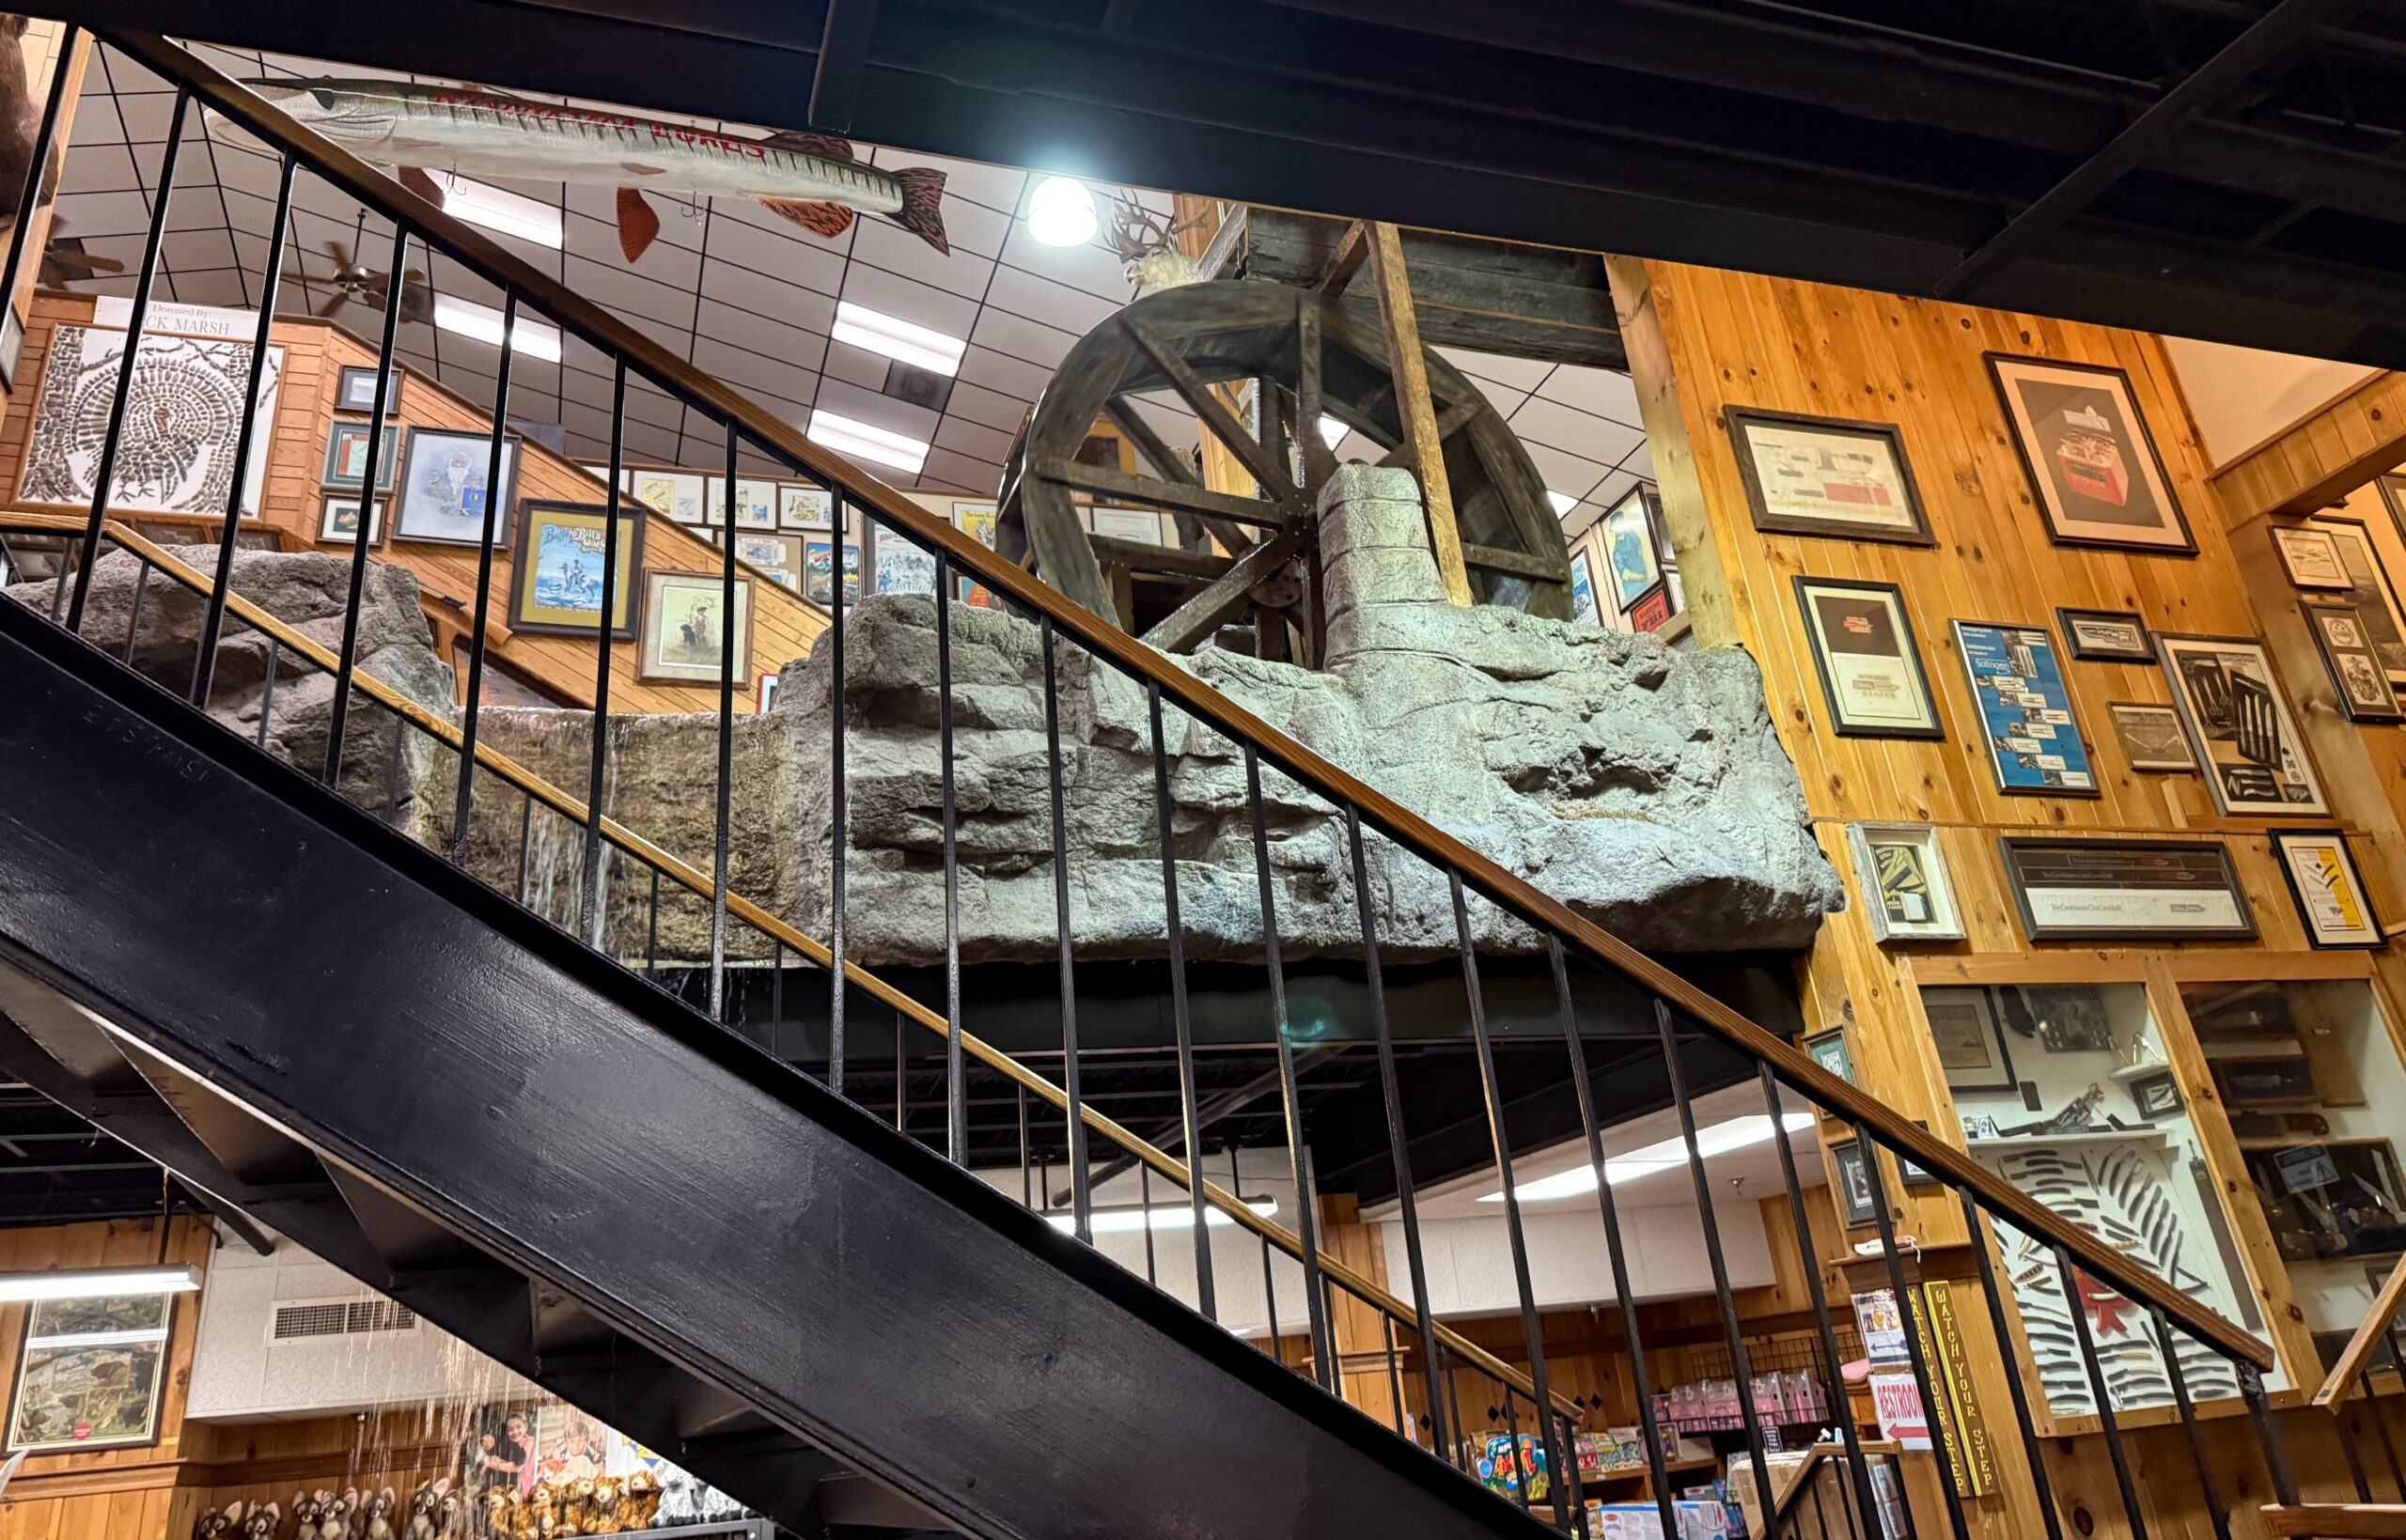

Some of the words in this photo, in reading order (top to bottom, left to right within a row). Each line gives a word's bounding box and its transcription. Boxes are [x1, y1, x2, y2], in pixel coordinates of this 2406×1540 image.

[654, 122, 765, 158] LURES
[152, 304, 195, 316] Donated
[196, 308, 211, 318] By:
[175, 319, 230, 335] MARSH
[1976, 659, 2010, 671] Solingen
[1907, 1289, 1931, 1359] WATCH
[1926, 1364, 1948, 1426] YOUR
[1945, 1432, 1964, 1492] STEP
[1935, 1289, 1961, 1358] WATCH
[1956, 1362, 1976, 1418] YOUR
[1973, 1428, 1992, 1486] STEP
